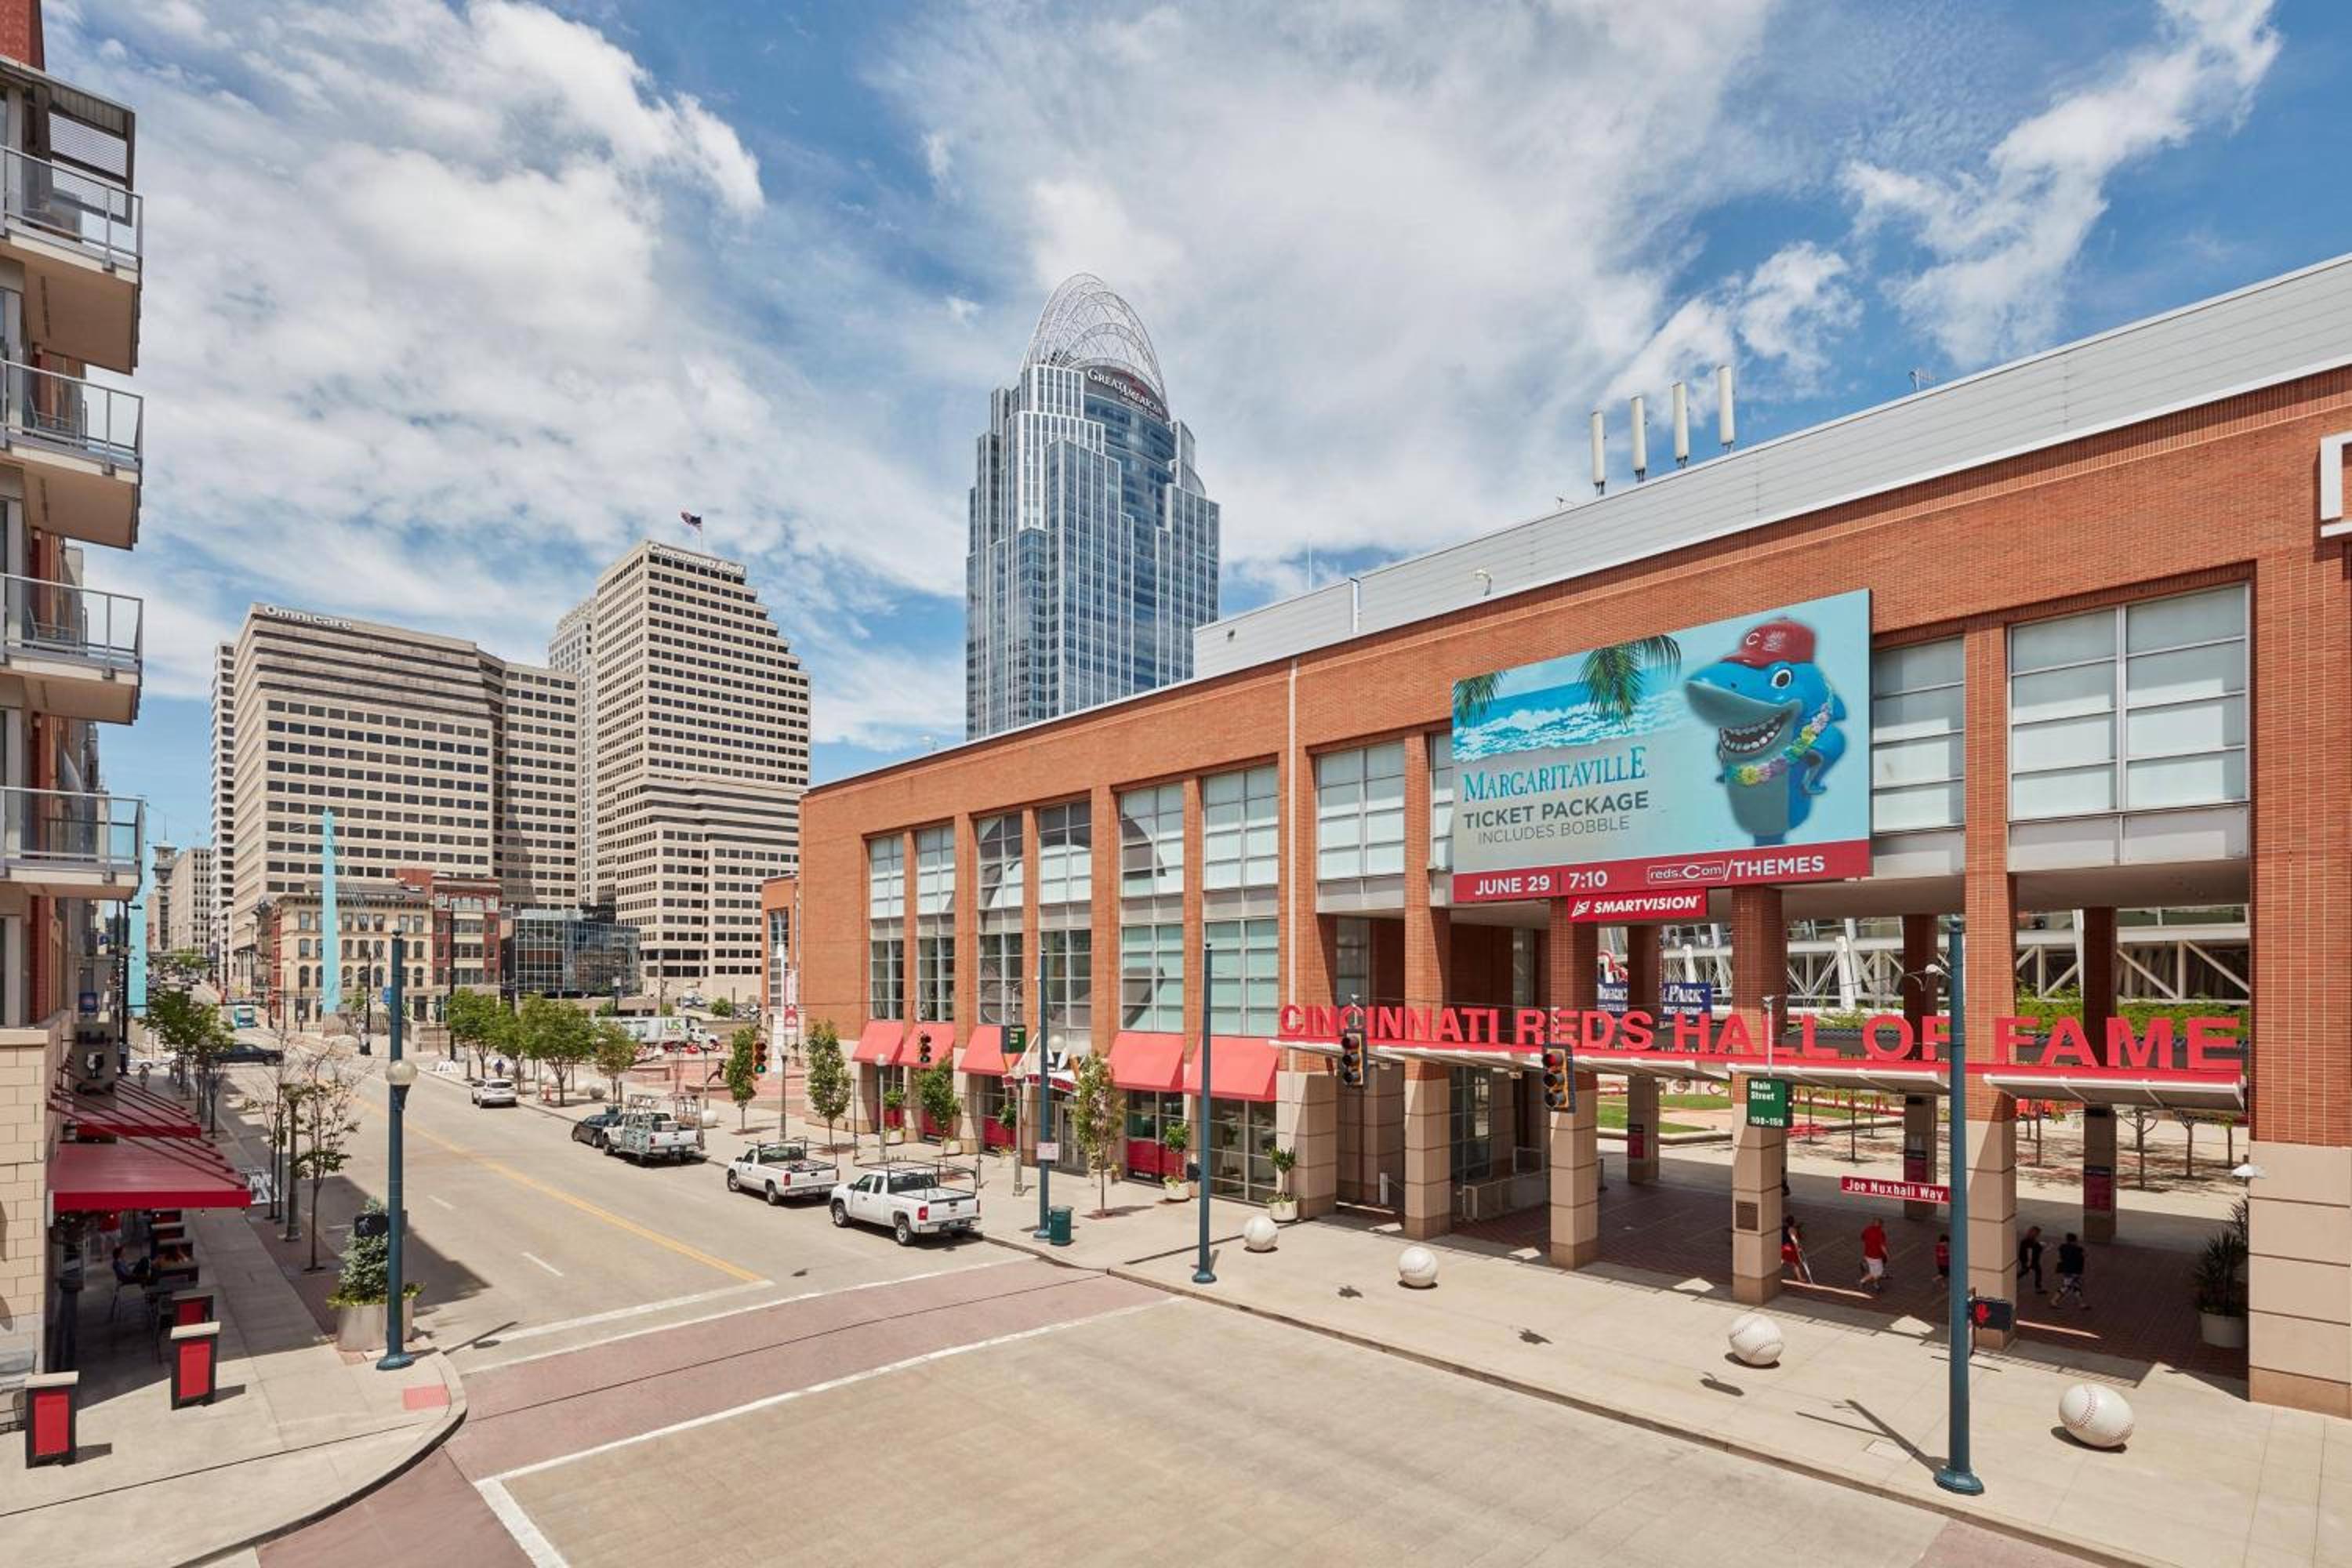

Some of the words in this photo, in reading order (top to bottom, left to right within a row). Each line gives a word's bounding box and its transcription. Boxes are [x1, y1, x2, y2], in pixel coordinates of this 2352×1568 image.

[265, 604, 351, 630] Omnicare
[1463, 746, 1646, 803] MARGARITAVILLE
[1463, 806, 1534, 829] TICKET
[1542, 790, 1649, 820] PACKAGE
[1479, 823, 1555, 844] INCLUDES
[1561, 815, 1630, 837] BOBBLE
[1475, 877, 1522, 895] JUNE
[1527, 875, 1550, 891] 29
[1569, 870, 1607, 889] 7:10
[1594, 896, 1699, 914] SMARTVISION
[1279, 1004, 1497, 1044] CINCINNATI
[1516, 1009, 1654, 1051] REDS
[1674, 1012, 1839, 1057] HALL
[1863, 1014, 1950, 1061] OF
[1994, 1016, 2242, 1071] FAME
[1751, 1081, 1770, 1090] Main
[1751, 1091, 1775, 1101] Street
[1846, 1179, 1866, 1191] Joe
[1871, 1182, 1915, 1197] Nuxhall
[1920, 1187, 1944, 1202] Way
